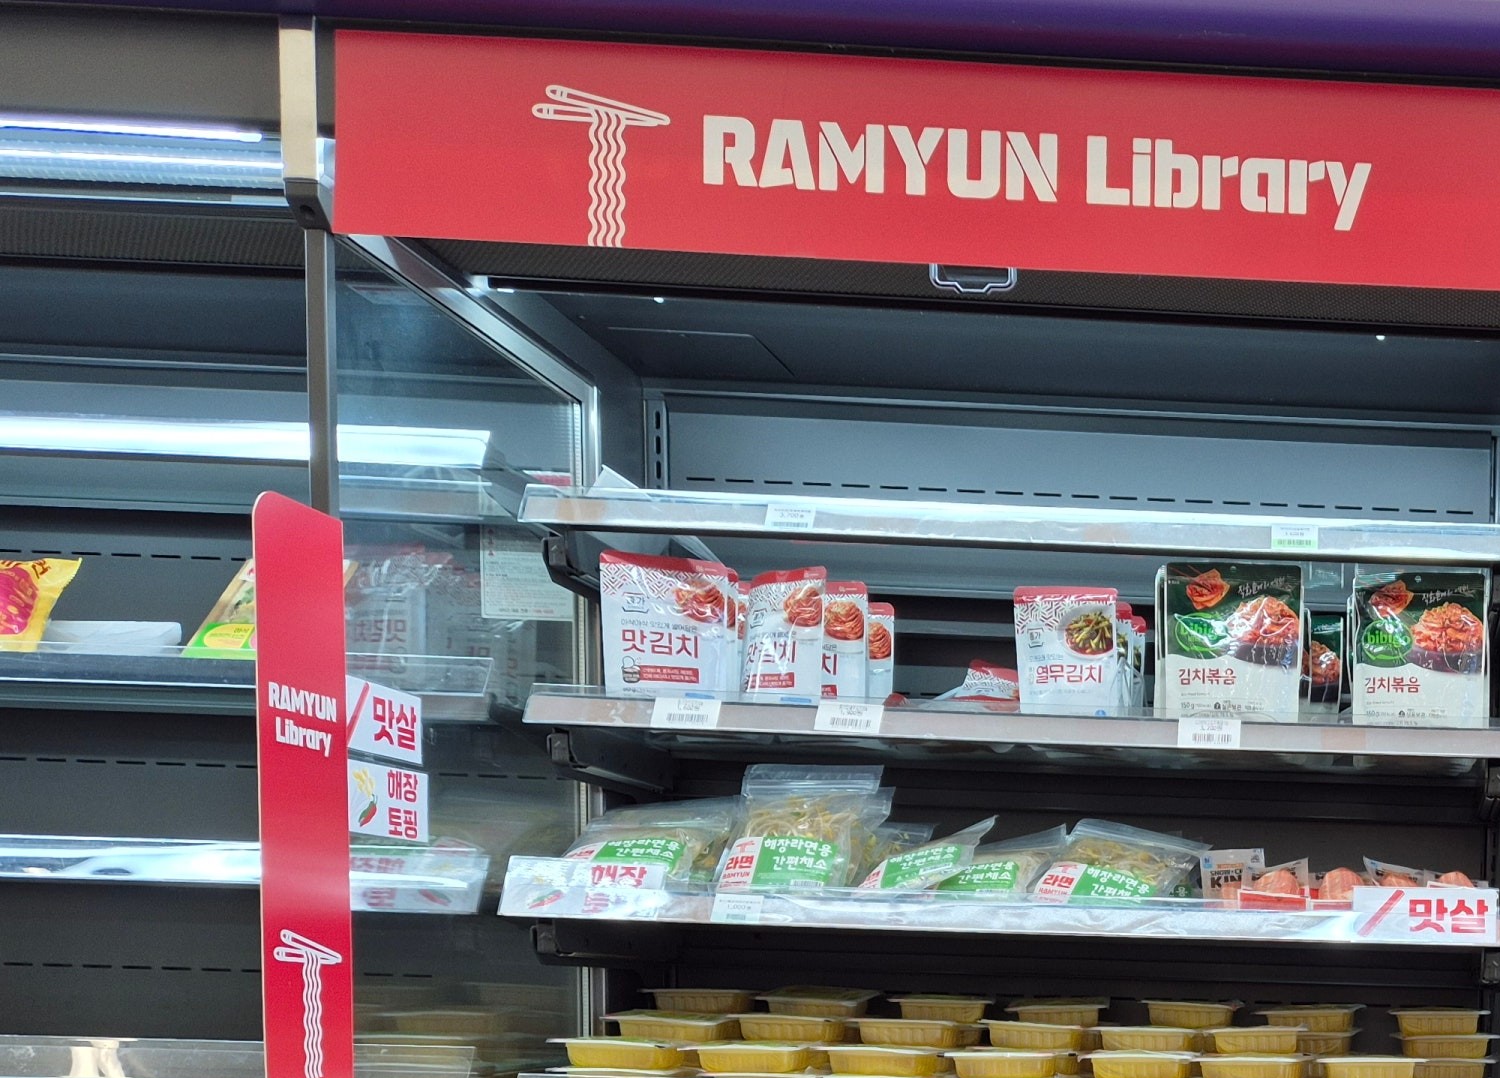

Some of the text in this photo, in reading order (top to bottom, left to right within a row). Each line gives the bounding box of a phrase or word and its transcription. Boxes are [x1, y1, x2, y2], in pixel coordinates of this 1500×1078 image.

[702, 114, 1371, 231] RAMYUN Library
[621, 628, 699, 659] 맛김치
[1036, 663, 1103, 684] 열무김치
[1178, 668, 1237, 686] 김치볶음
[1364, 676, 1421, 694] 김치볶음
[268, 681, 338, 723] RAMYUN
[275, 716, 332, 758] Library
[372, 695, 417, 751] 맛살
[387, 768, 418, 804] 해장
[387, 806, 418, 840] 토핑
[764, 838, 833, 857] 해장라면용
[591, 864, 648, 889] 해장
[725, 854, 755, 871] 라면
[772, 855, 828, 871] 간편채소
[1041, 873, 1076, 889] 라면
[1086, 866, 1150, 894] 해장라면용
[1408, 897, 1489, 934] 맛살
